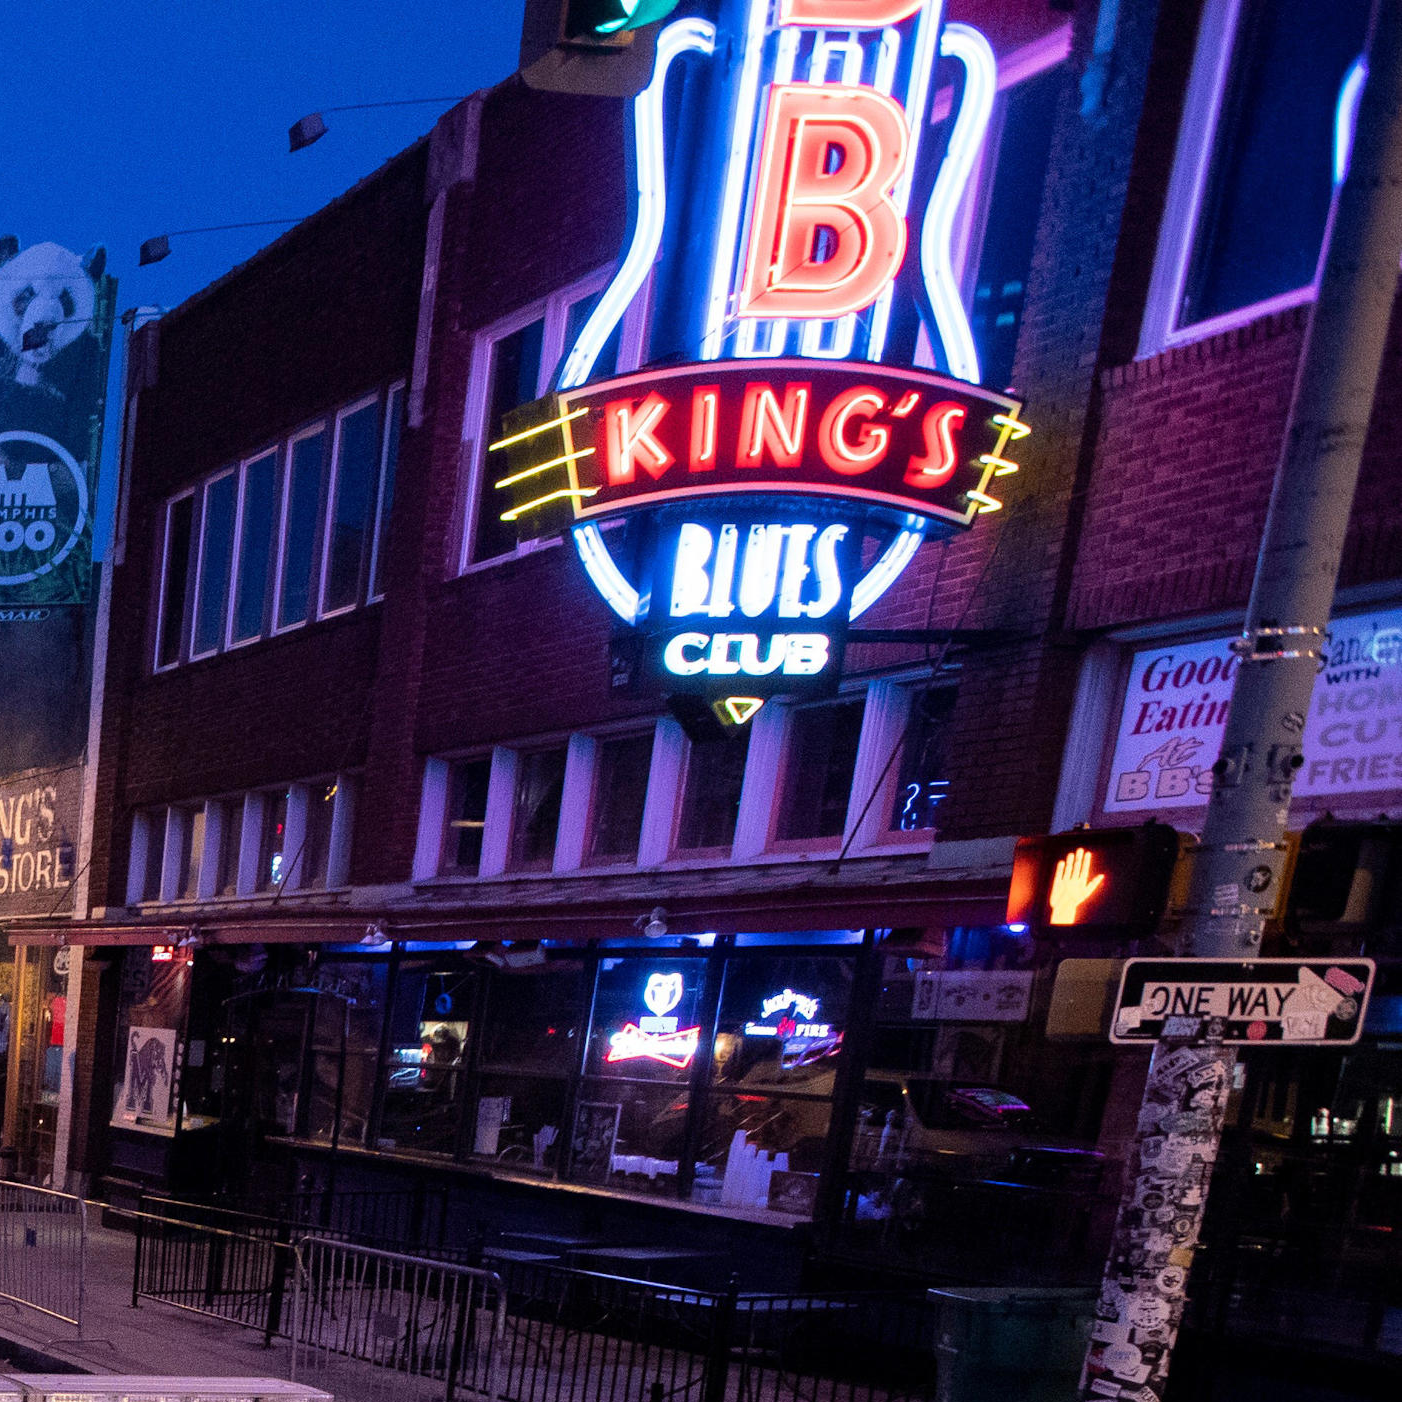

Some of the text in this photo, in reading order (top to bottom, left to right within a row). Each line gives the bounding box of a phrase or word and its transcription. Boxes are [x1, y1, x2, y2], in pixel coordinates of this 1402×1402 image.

[605, 381, 967, 489] KING'S
[670, 523, 849, 618] BLUES
[664, 632, 829, 676] CLUB
[1325, 667, 1380, 685] WITH
[1150, 986, 1297, 1017] ONE WAY
[795, 1024, 830, 1037] FIRE
